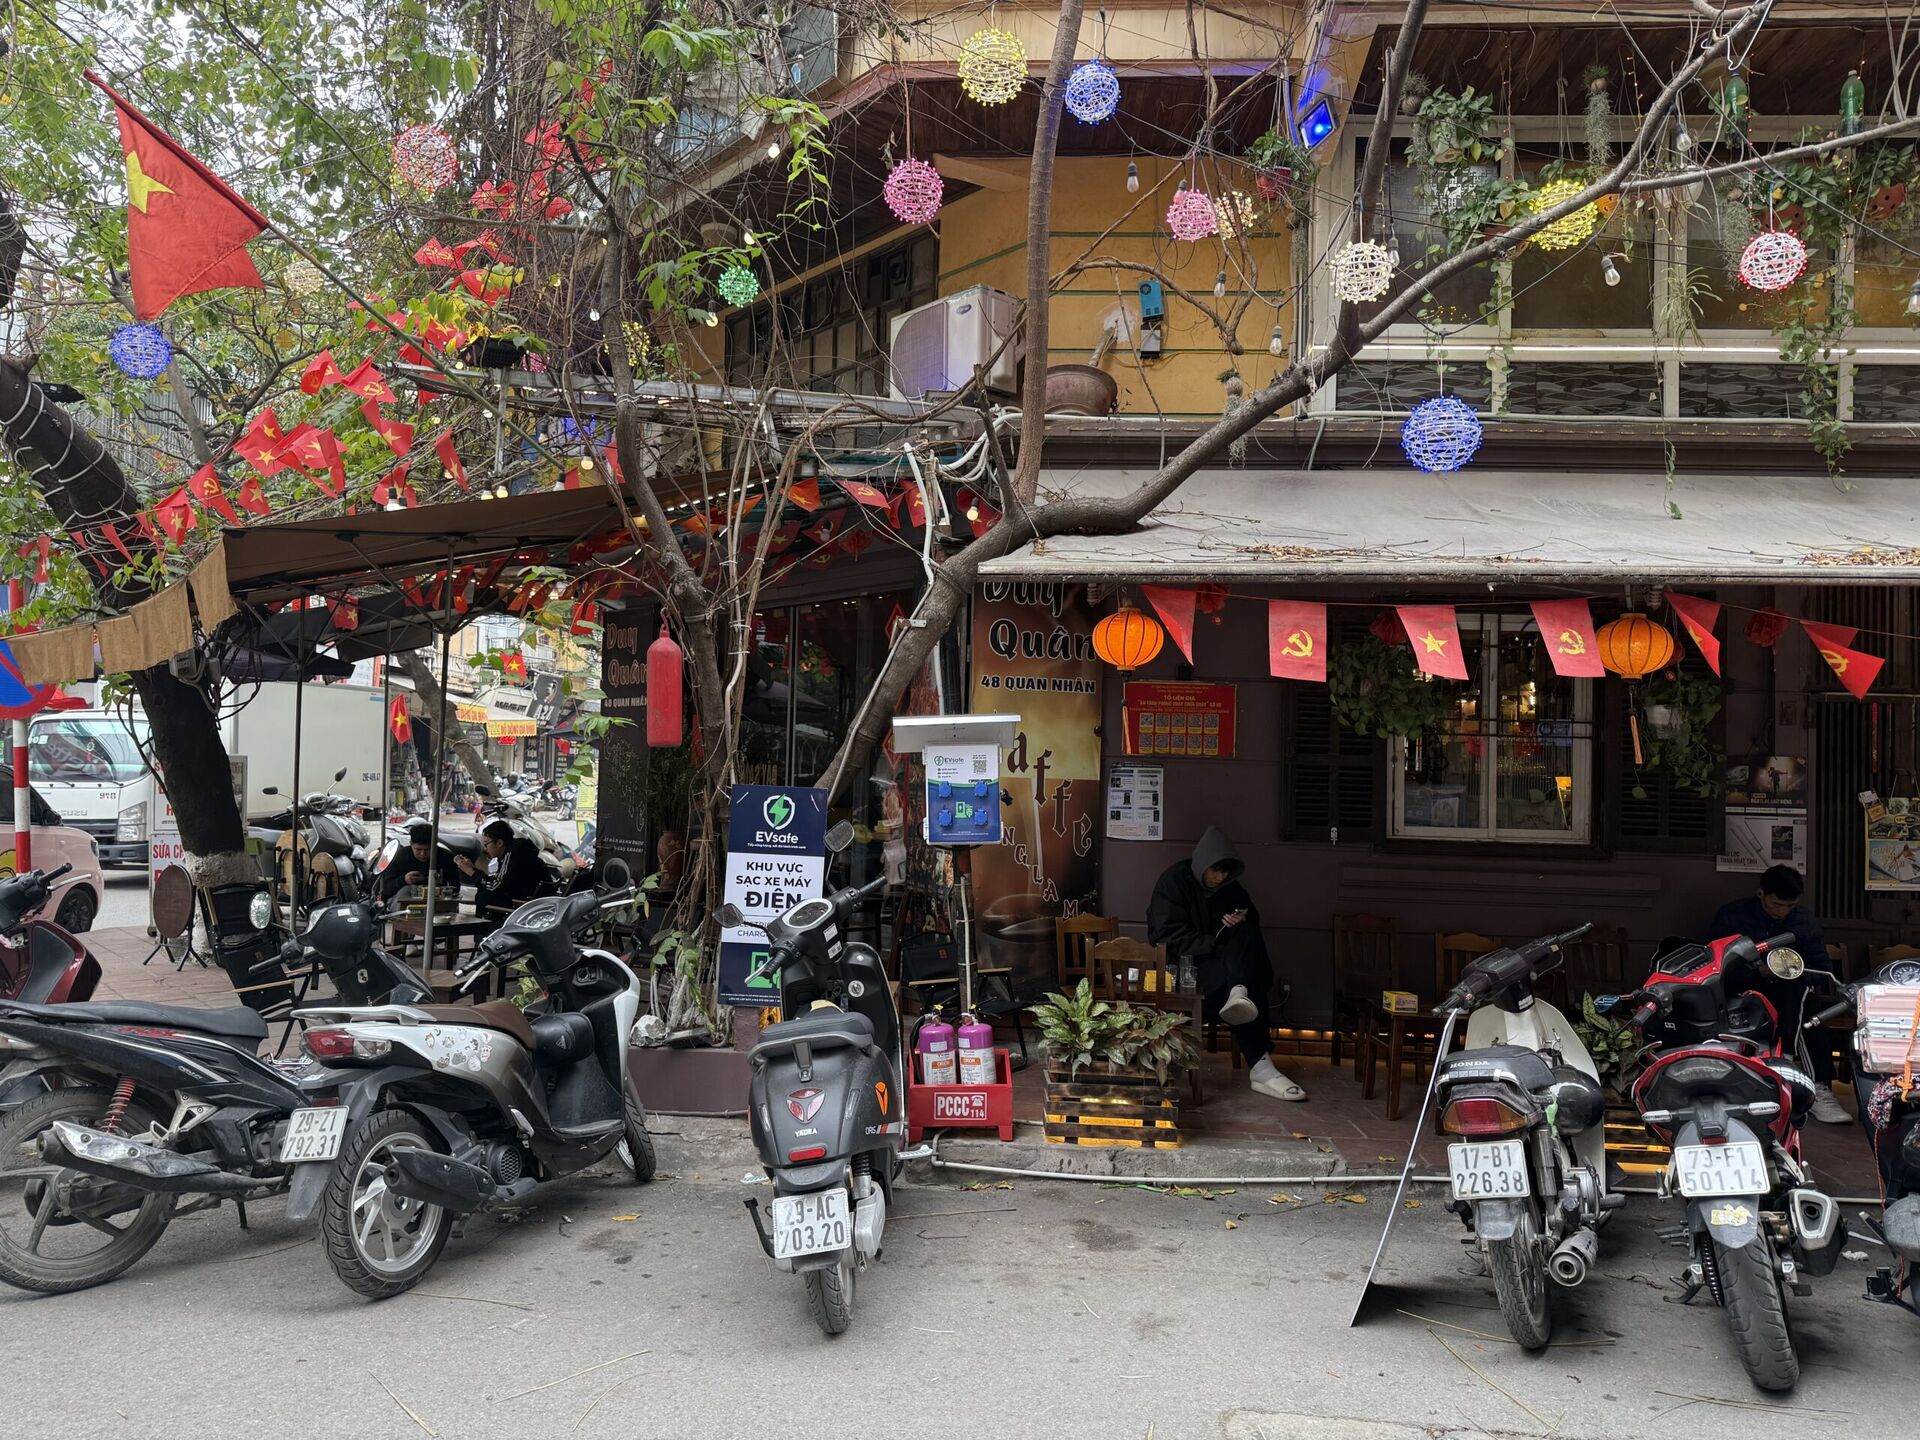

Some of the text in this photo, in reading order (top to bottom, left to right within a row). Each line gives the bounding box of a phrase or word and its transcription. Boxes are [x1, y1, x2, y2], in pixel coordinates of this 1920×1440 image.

[606, 623, 638, 655] Duy
[988, 617, 1097, 661] Quân
[981, 675, 1096, 694] 48 QUAN NHÂN
[613, 698, 629, 707] QUAN
[1004, 730, 1092, 857] affe
[755, 831, 799, 844] EVsafe
[152, 840, 171, 859] SỬA
[746, 861, 803, 875] KHU VỰC
[735, 875, 812, 888] SẠC XE MÁY
[744, 888, 803, 914] ĐIỆN
[1450, 1060, 1490, 1069] HONDA
[937, 1096, 984, 1118] PCCC 114
[294, 1110, 338, 1134] 29-Z1
[794, 1127, 818, 1138] YADEA
[283, 1135, 337, 1160] 792.31
[1460, 1144, 1512, 1170] 17-B1
[1456, 1170, 1525, 1196] 226.38
[1684, 1169, 1762, 1192] 501.14
[784, 1195, 836, 1226] 29-AC
[780, 1220, 845, 1254] 703.20
